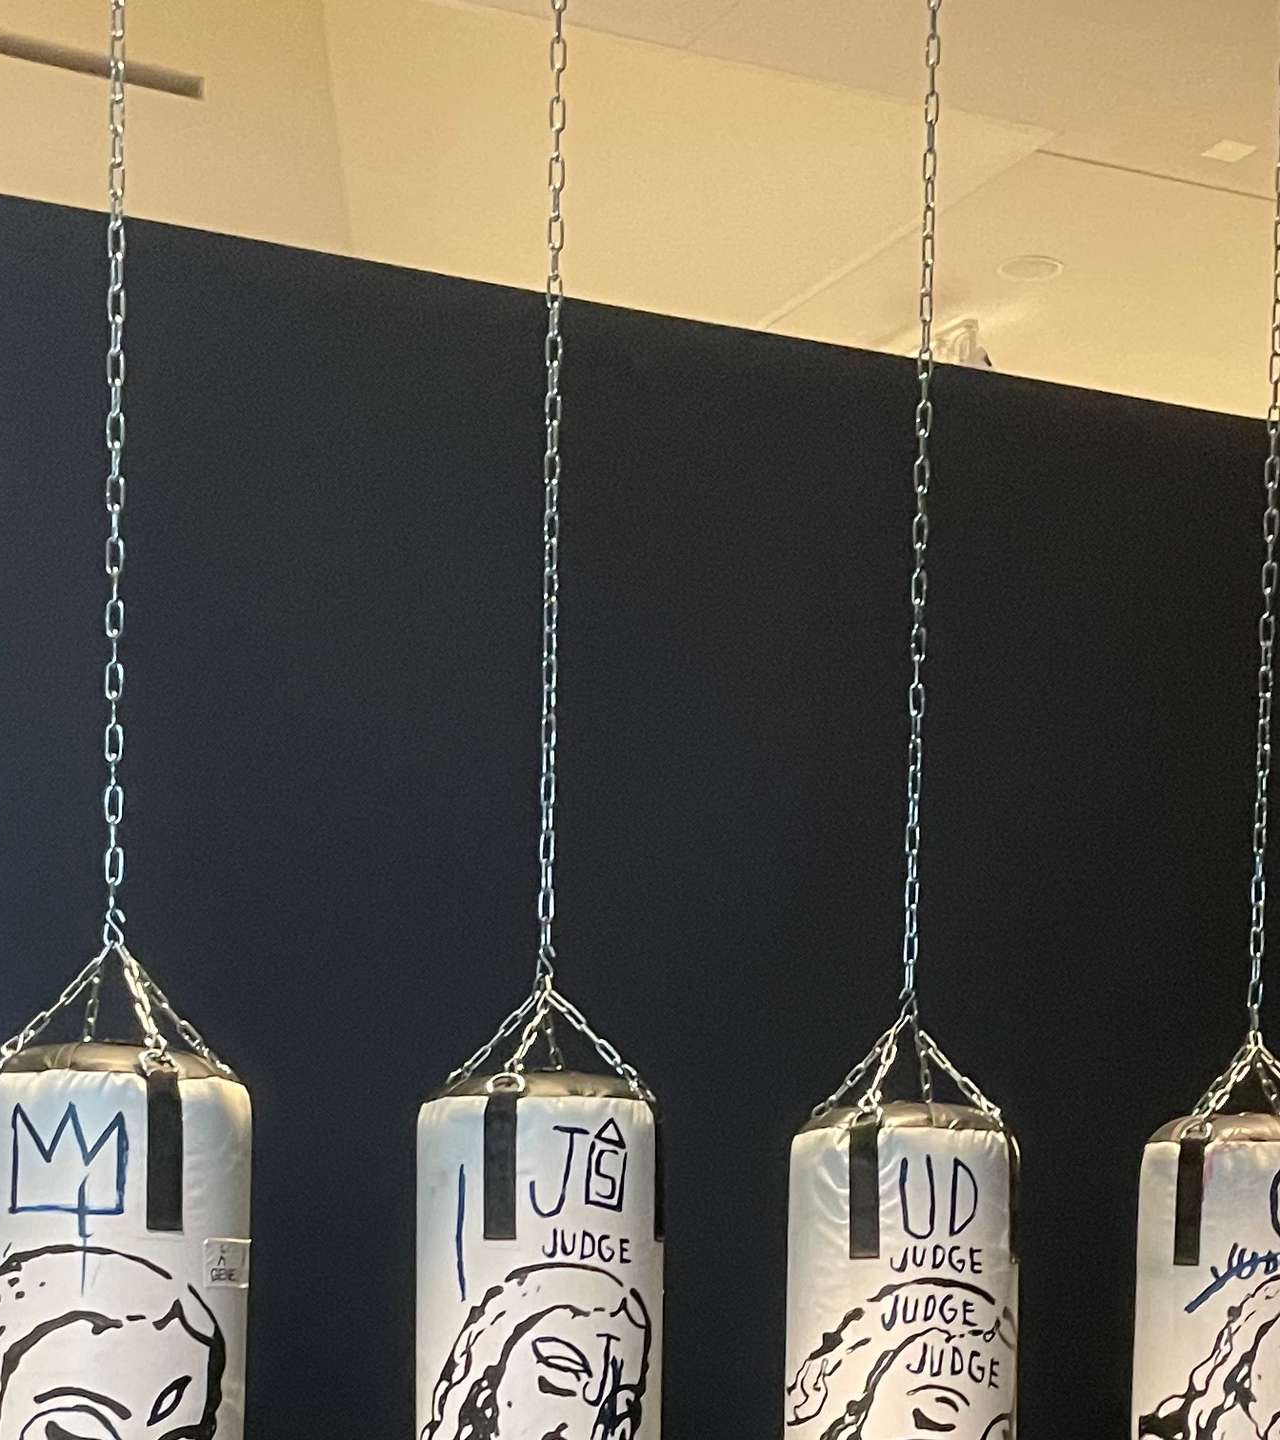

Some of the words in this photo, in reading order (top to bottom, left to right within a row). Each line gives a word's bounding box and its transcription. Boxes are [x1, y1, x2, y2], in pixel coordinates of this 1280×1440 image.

[541, 1227, 632, 1264] JUDGE
[889, 1244, 983, 1274] JUDGE
[880, 1293, 978, 1331] JUDGE
[905, 1341, 1001, 1389] JUDGE
